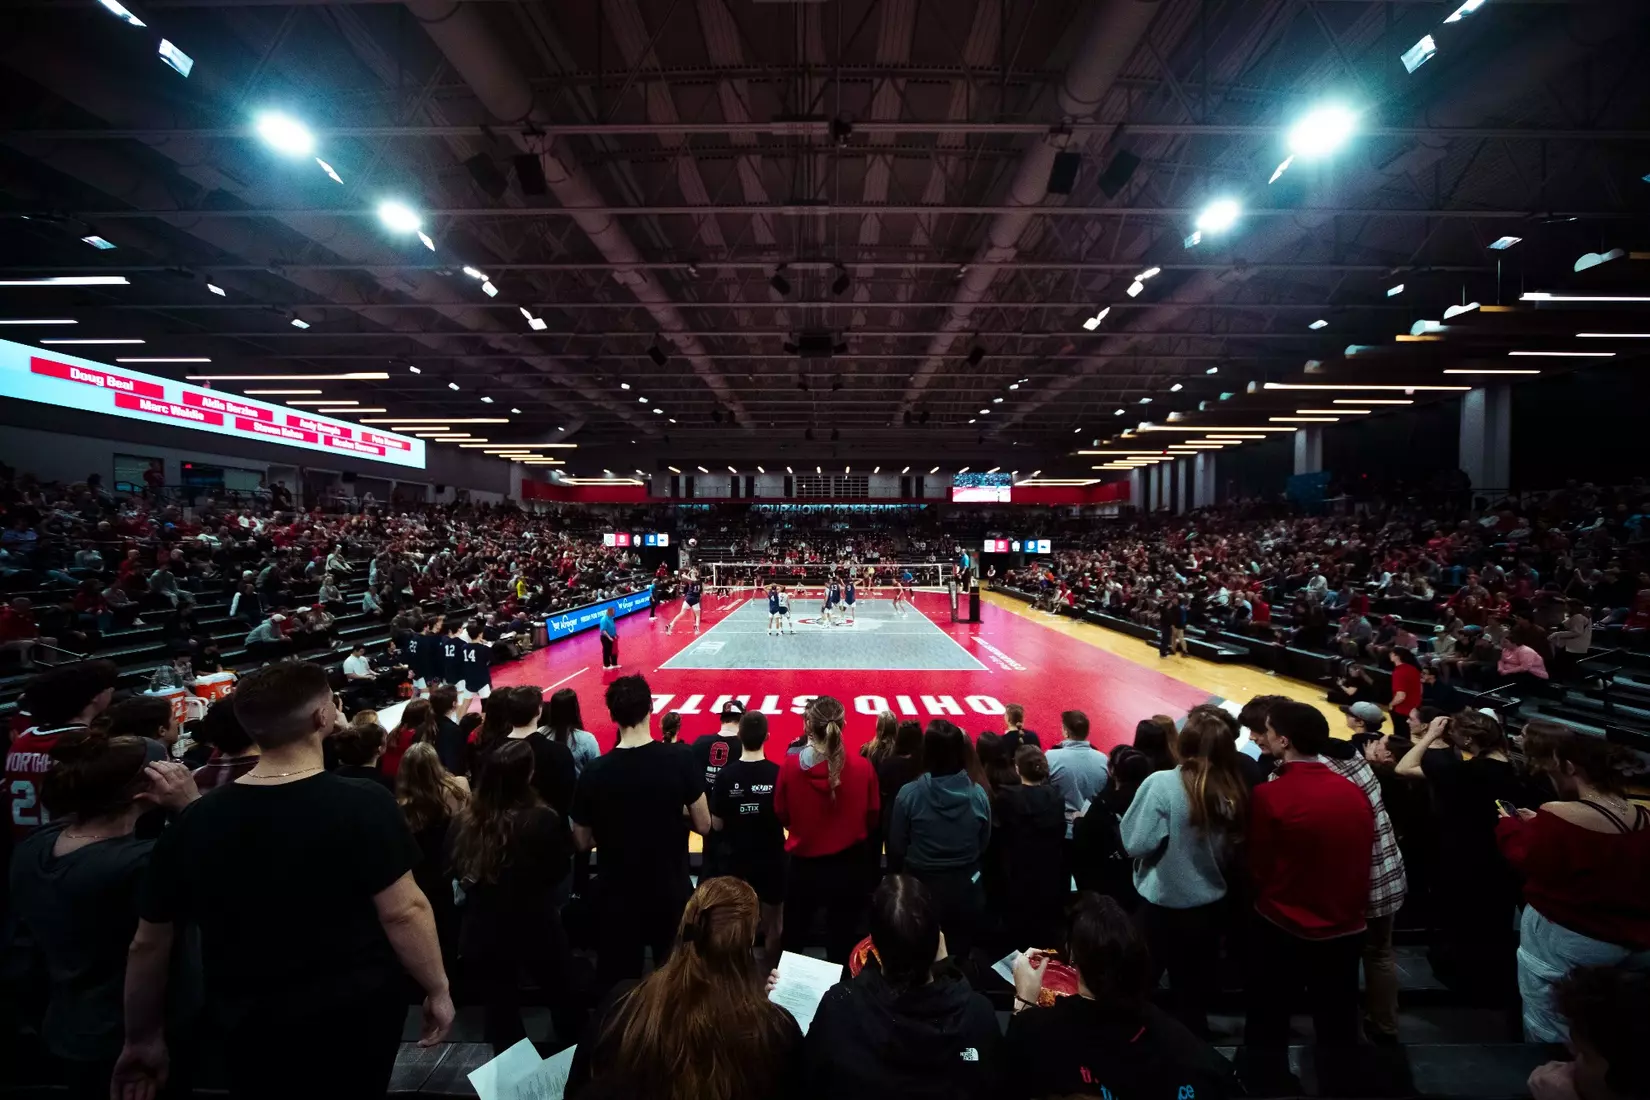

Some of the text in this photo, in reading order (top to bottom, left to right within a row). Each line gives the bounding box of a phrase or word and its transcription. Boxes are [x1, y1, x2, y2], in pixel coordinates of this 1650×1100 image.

[70, 367, 134, 391] Doug Beal
[140, 399, 204, 421] Marc Waldie
[444, 644, 456, 657] 12
[462, 648, 476, 663] 14
[854, 694, 1006, 715] OHIO
